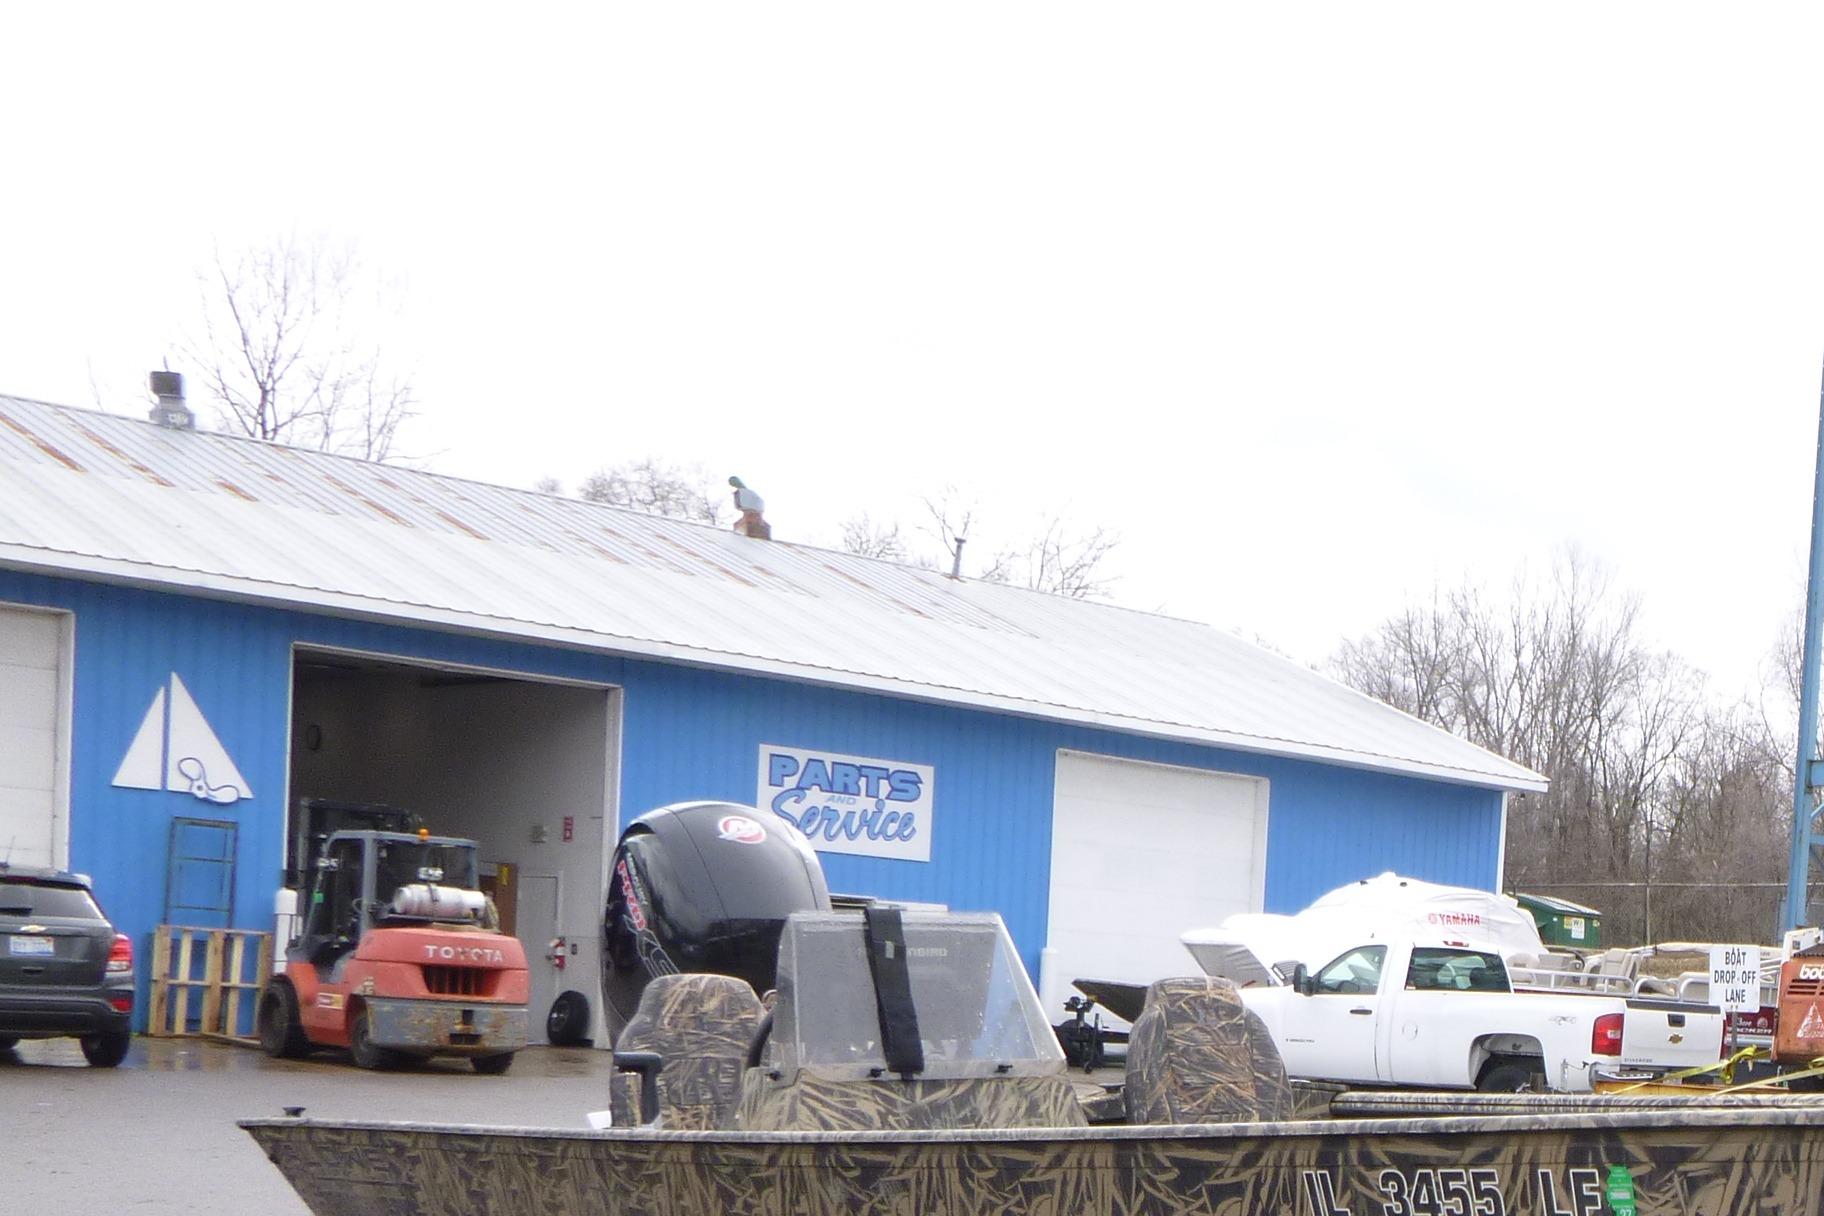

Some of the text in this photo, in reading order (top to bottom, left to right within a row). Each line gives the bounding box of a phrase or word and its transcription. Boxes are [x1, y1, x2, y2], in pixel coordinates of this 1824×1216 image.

[769, 753, 923, 803] PARTS
[826, 794, 857, 806] AND
[771, 787, 917, 842] Service
[1439, 912, 1481, 927] YAMAHA
[424, 944, 504, 962] TOYOTA
[1725, 951, 1747, 967] BOAT
[1725, 988, 1747, 1004] LANE
